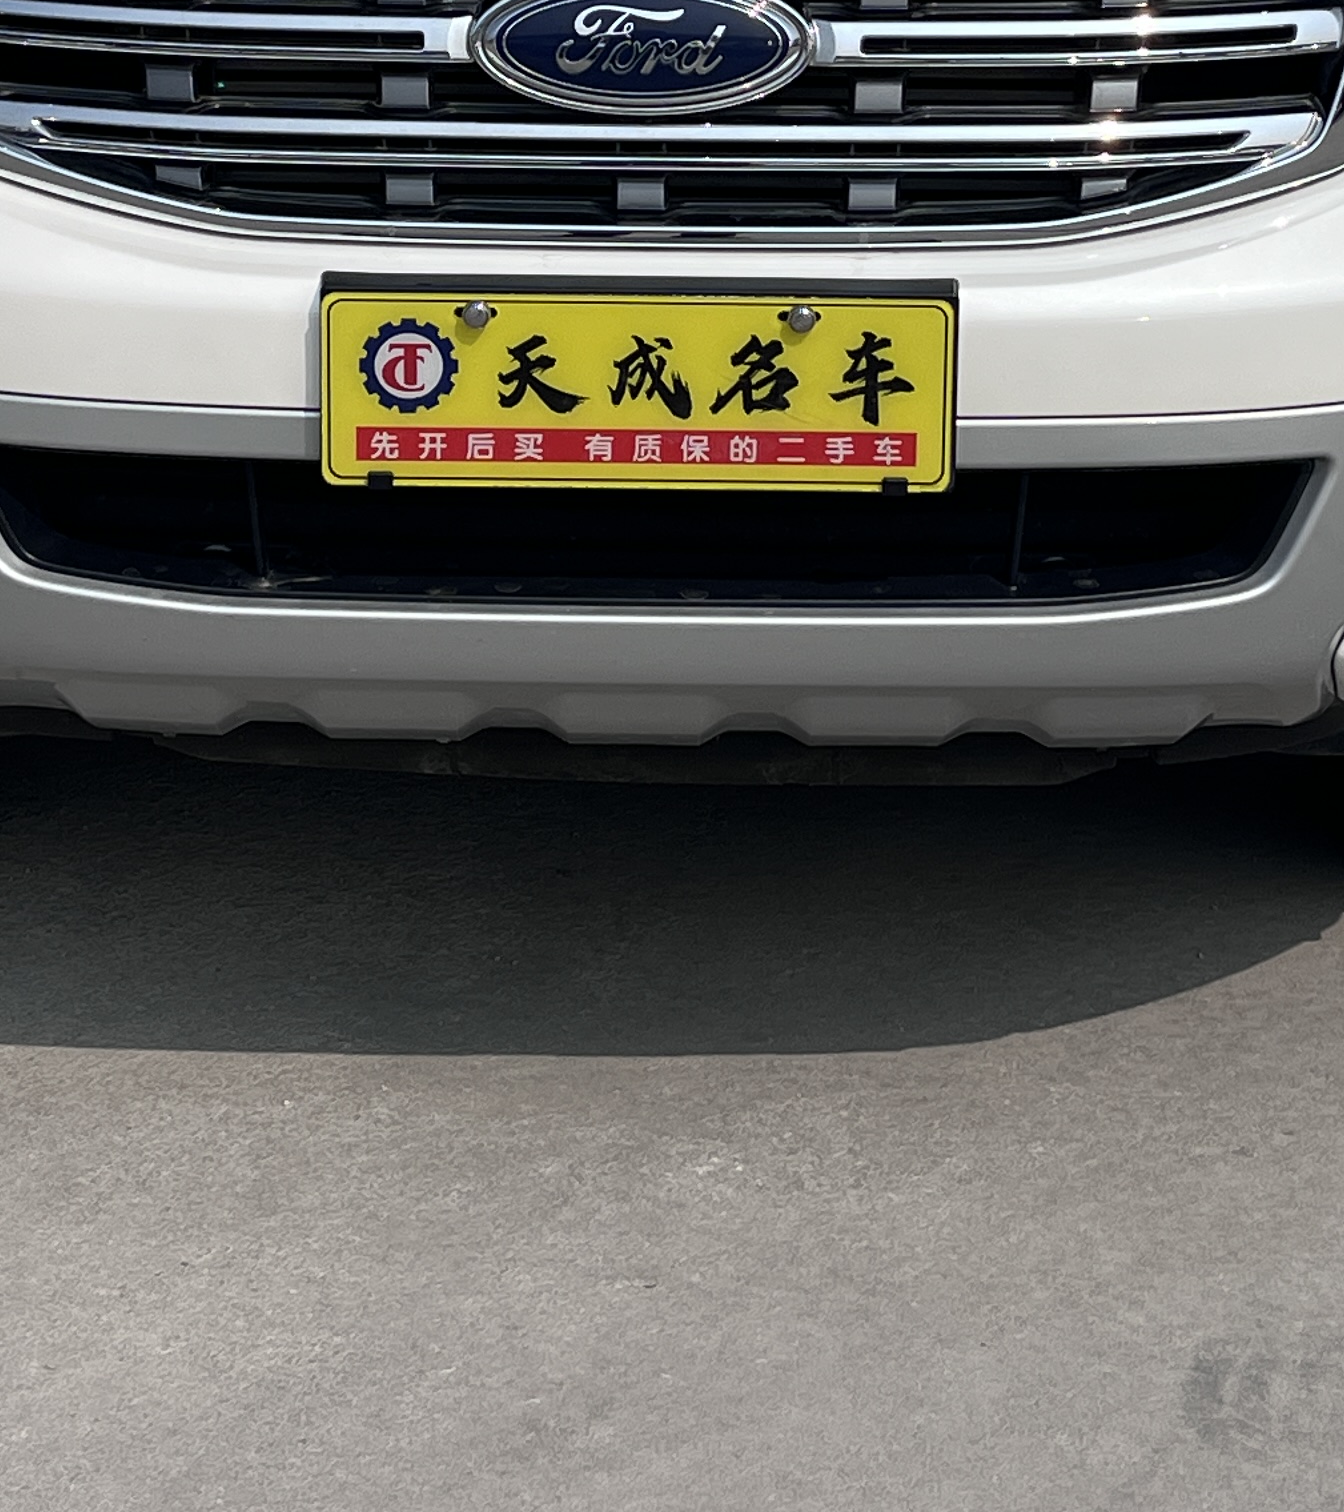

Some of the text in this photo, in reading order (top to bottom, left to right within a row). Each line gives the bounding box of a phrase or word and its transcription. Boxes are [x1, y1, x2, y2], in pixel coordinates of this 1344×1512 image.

[558, 4, 728, 76] Ford
[497, 331, 916, 427] 天成名车
[370, 431, 903, 466] 先开后买 有质保的二手车
